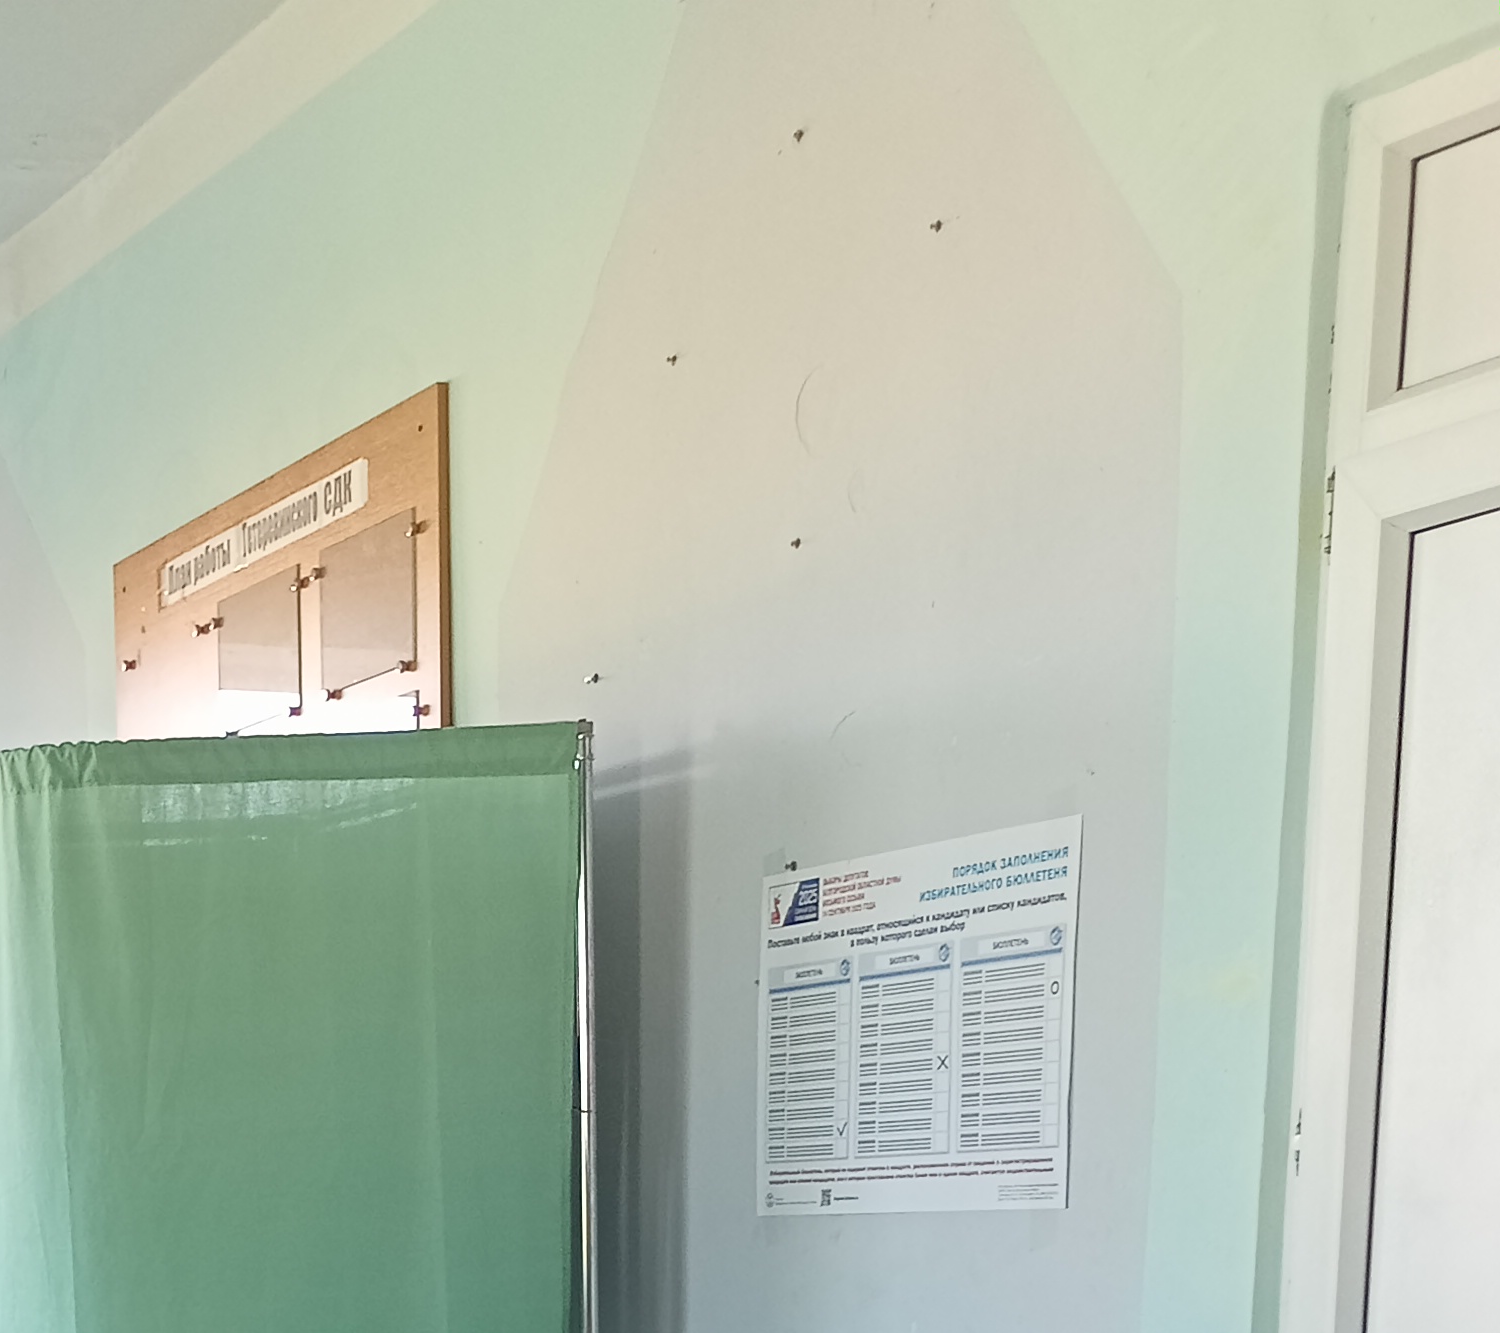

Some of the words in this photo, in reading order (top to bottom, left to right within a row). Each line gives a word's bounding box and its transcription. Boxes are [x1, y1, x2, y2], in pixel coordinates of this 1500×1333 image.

[324, 469, 353, 517] СДК
[952, 859, 998, 878] ПОРЯДОК
[1000, 846, 1069, 870] ЗАПОЛНЕНИЯ
[919, 877, 1003, 903] ИЗБИРАТЕЛЬНОГО
[1006, 865, 1068, 888] БЮЛЛЕТЕНЯ
